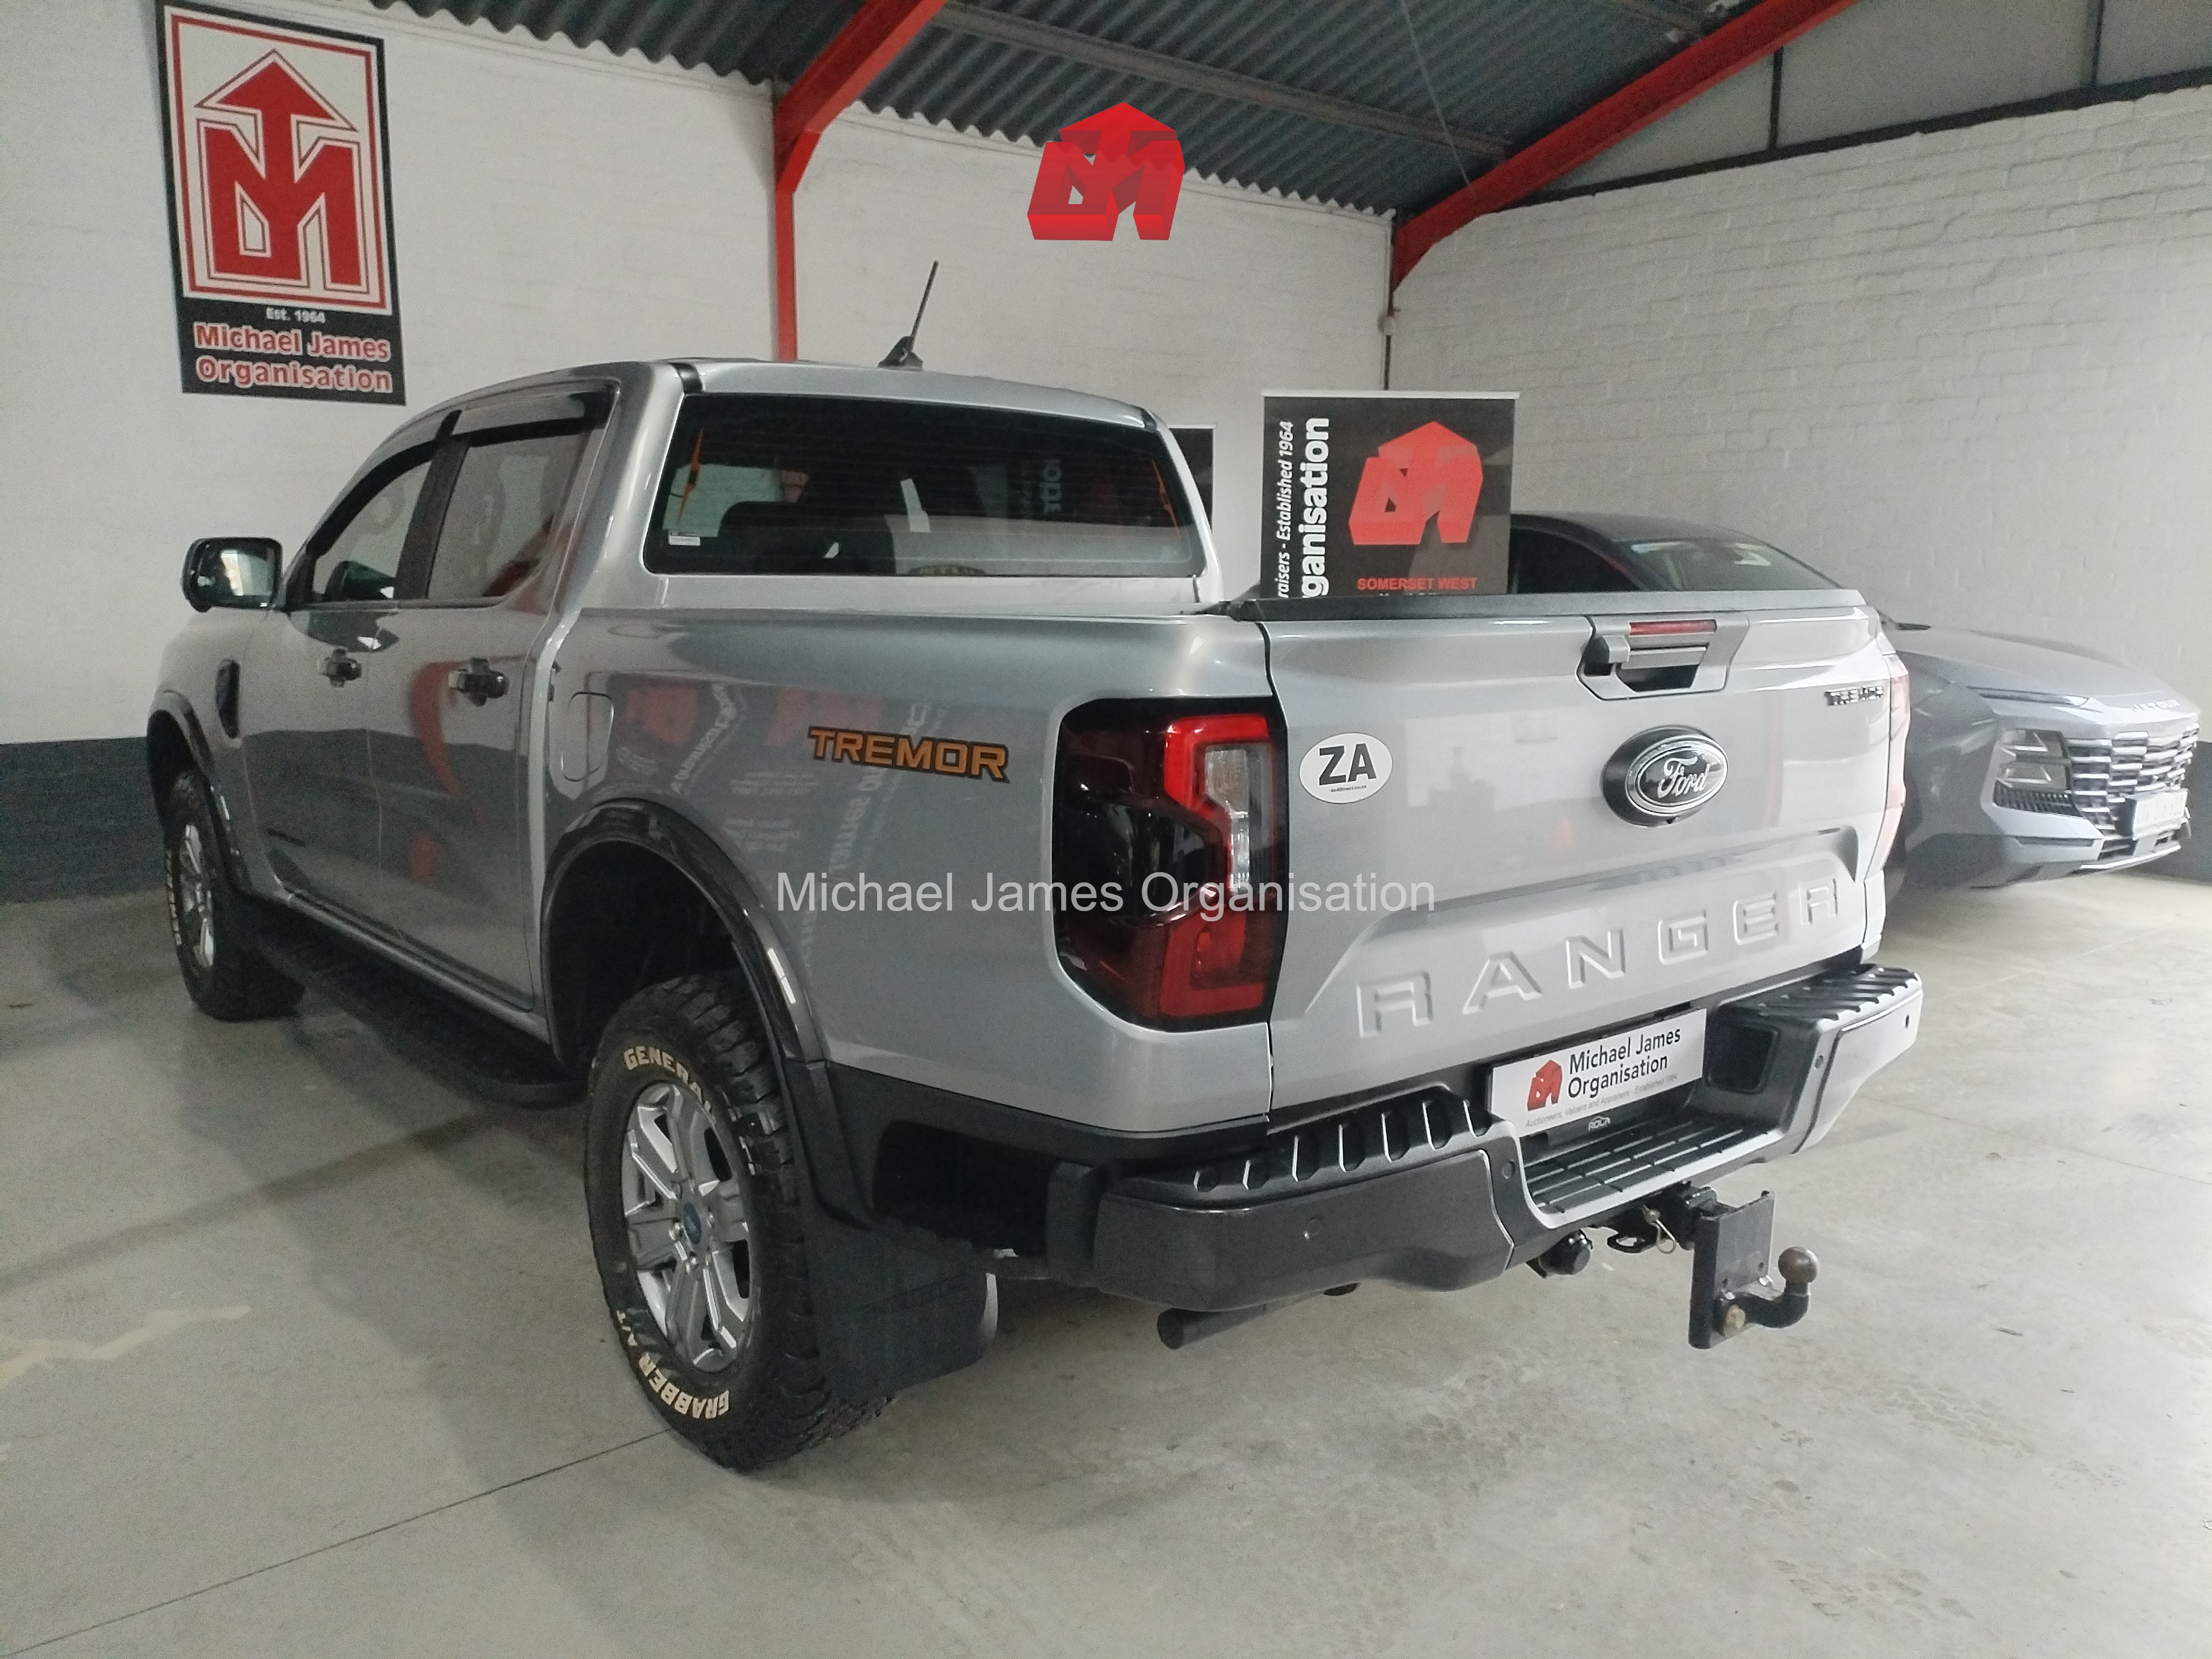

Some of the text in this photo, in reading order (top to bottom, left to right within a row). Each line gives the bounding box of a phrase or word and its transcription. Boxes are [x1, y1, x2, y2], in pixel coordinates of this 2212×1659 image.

[266, 308, 291, 321] Est.
[194, 321, 390, 362] Michael James
[196, 355, 393, 393] Organisation
[1278, 421, 1293, 457] 1964
[1277, 459, 1292, 541] Established
[1298, 417, 1330, 598] ganisation
[1357, 577, 1478, 590] SOMERSET WEST
[809, 726, 1010, 783] TREMOR
[1319, 743, 1377, 785] ZA
[1657, 755, 1710, 798] Ford
[1357, 878, 1839, 1038] RANGER
[1569, 1027, 1681, 1075] Michael James
[1568, 1055, 1668, 1098] Organisation
